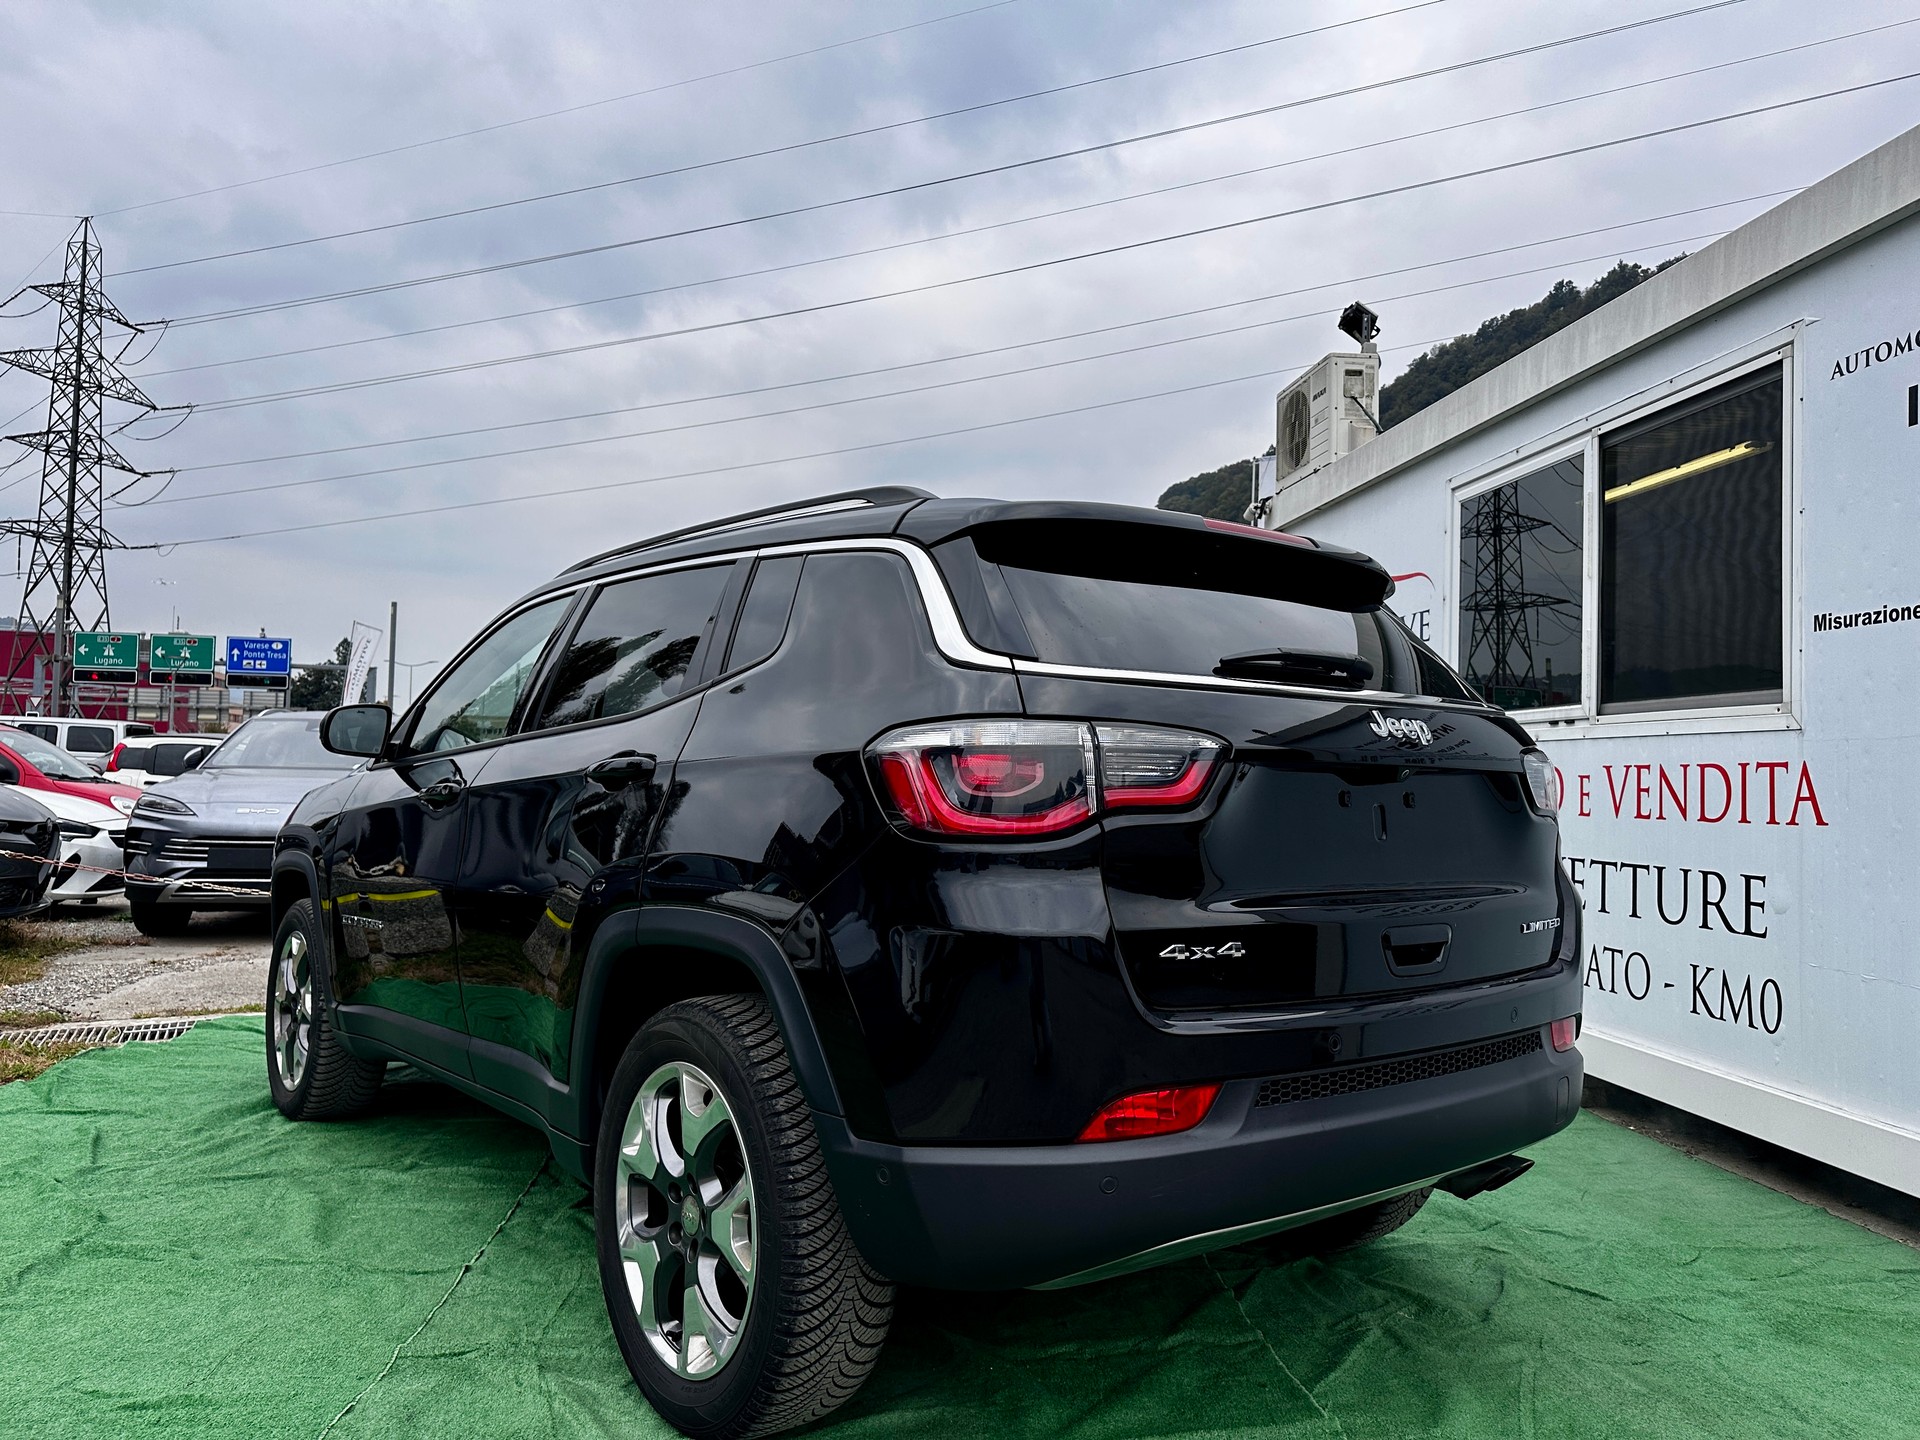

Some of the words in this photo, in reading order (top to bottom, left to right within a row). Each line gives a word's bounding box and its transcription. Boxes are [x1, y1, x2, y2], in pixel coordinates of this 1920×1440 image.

[1813, 604, 1920, 632] Misurazione
[243, 650, 265, 658] Ponte
[267, 651, 286, 659] Tresa
[244, 641, 270, 649] Varese
[94, 657, 123, 665] Lugano
[1369, 709, 1434, 746] Jeep
[1577, 774, 1591, 817] E
[1602, 760, 1829, 826] VENDITA
[1561, 856, 1768, 939] ETTURE
[1521, 917, 1561, 934] LIMITED
[1159, 941, 1246, 960] 4x4
